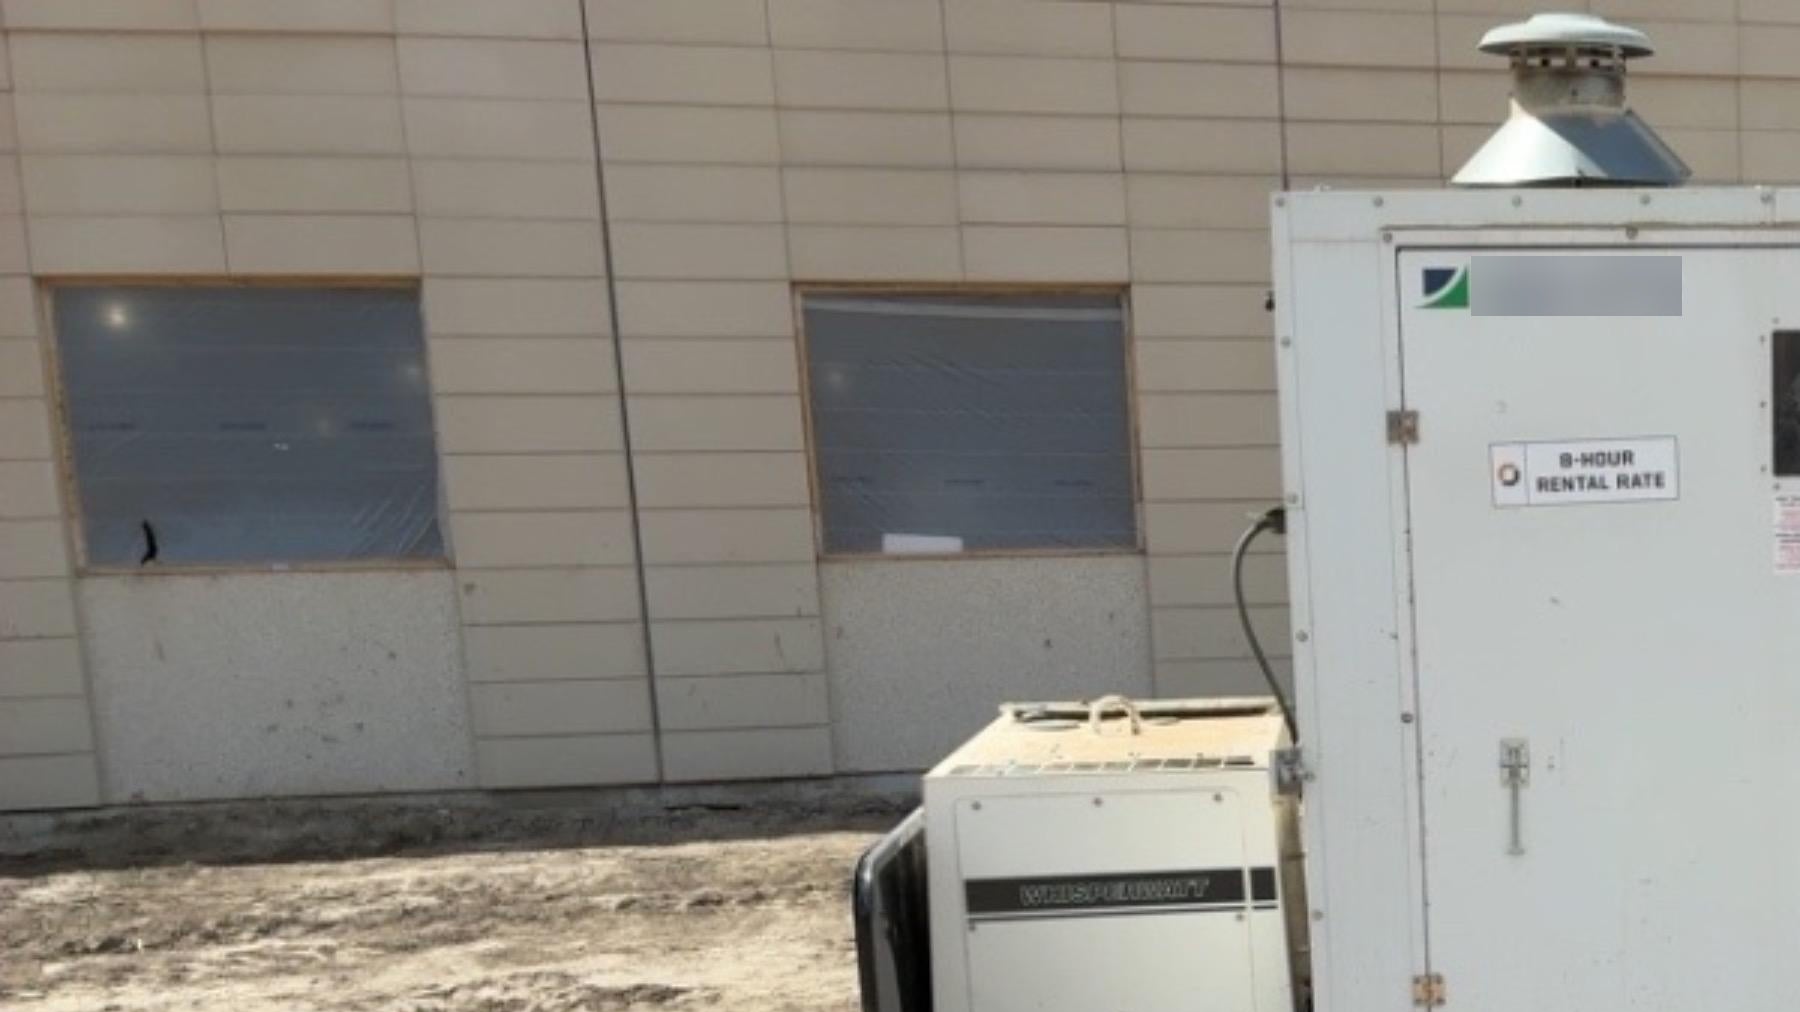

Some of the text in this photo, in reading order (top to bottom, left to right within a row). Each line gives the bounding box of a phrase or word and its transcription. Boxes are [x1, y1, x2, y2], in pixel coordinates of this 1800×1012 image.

[1559, 449, 1635, 469] 8-HOUR
[1536, 471, 1667, 493] RENTAL RATE
